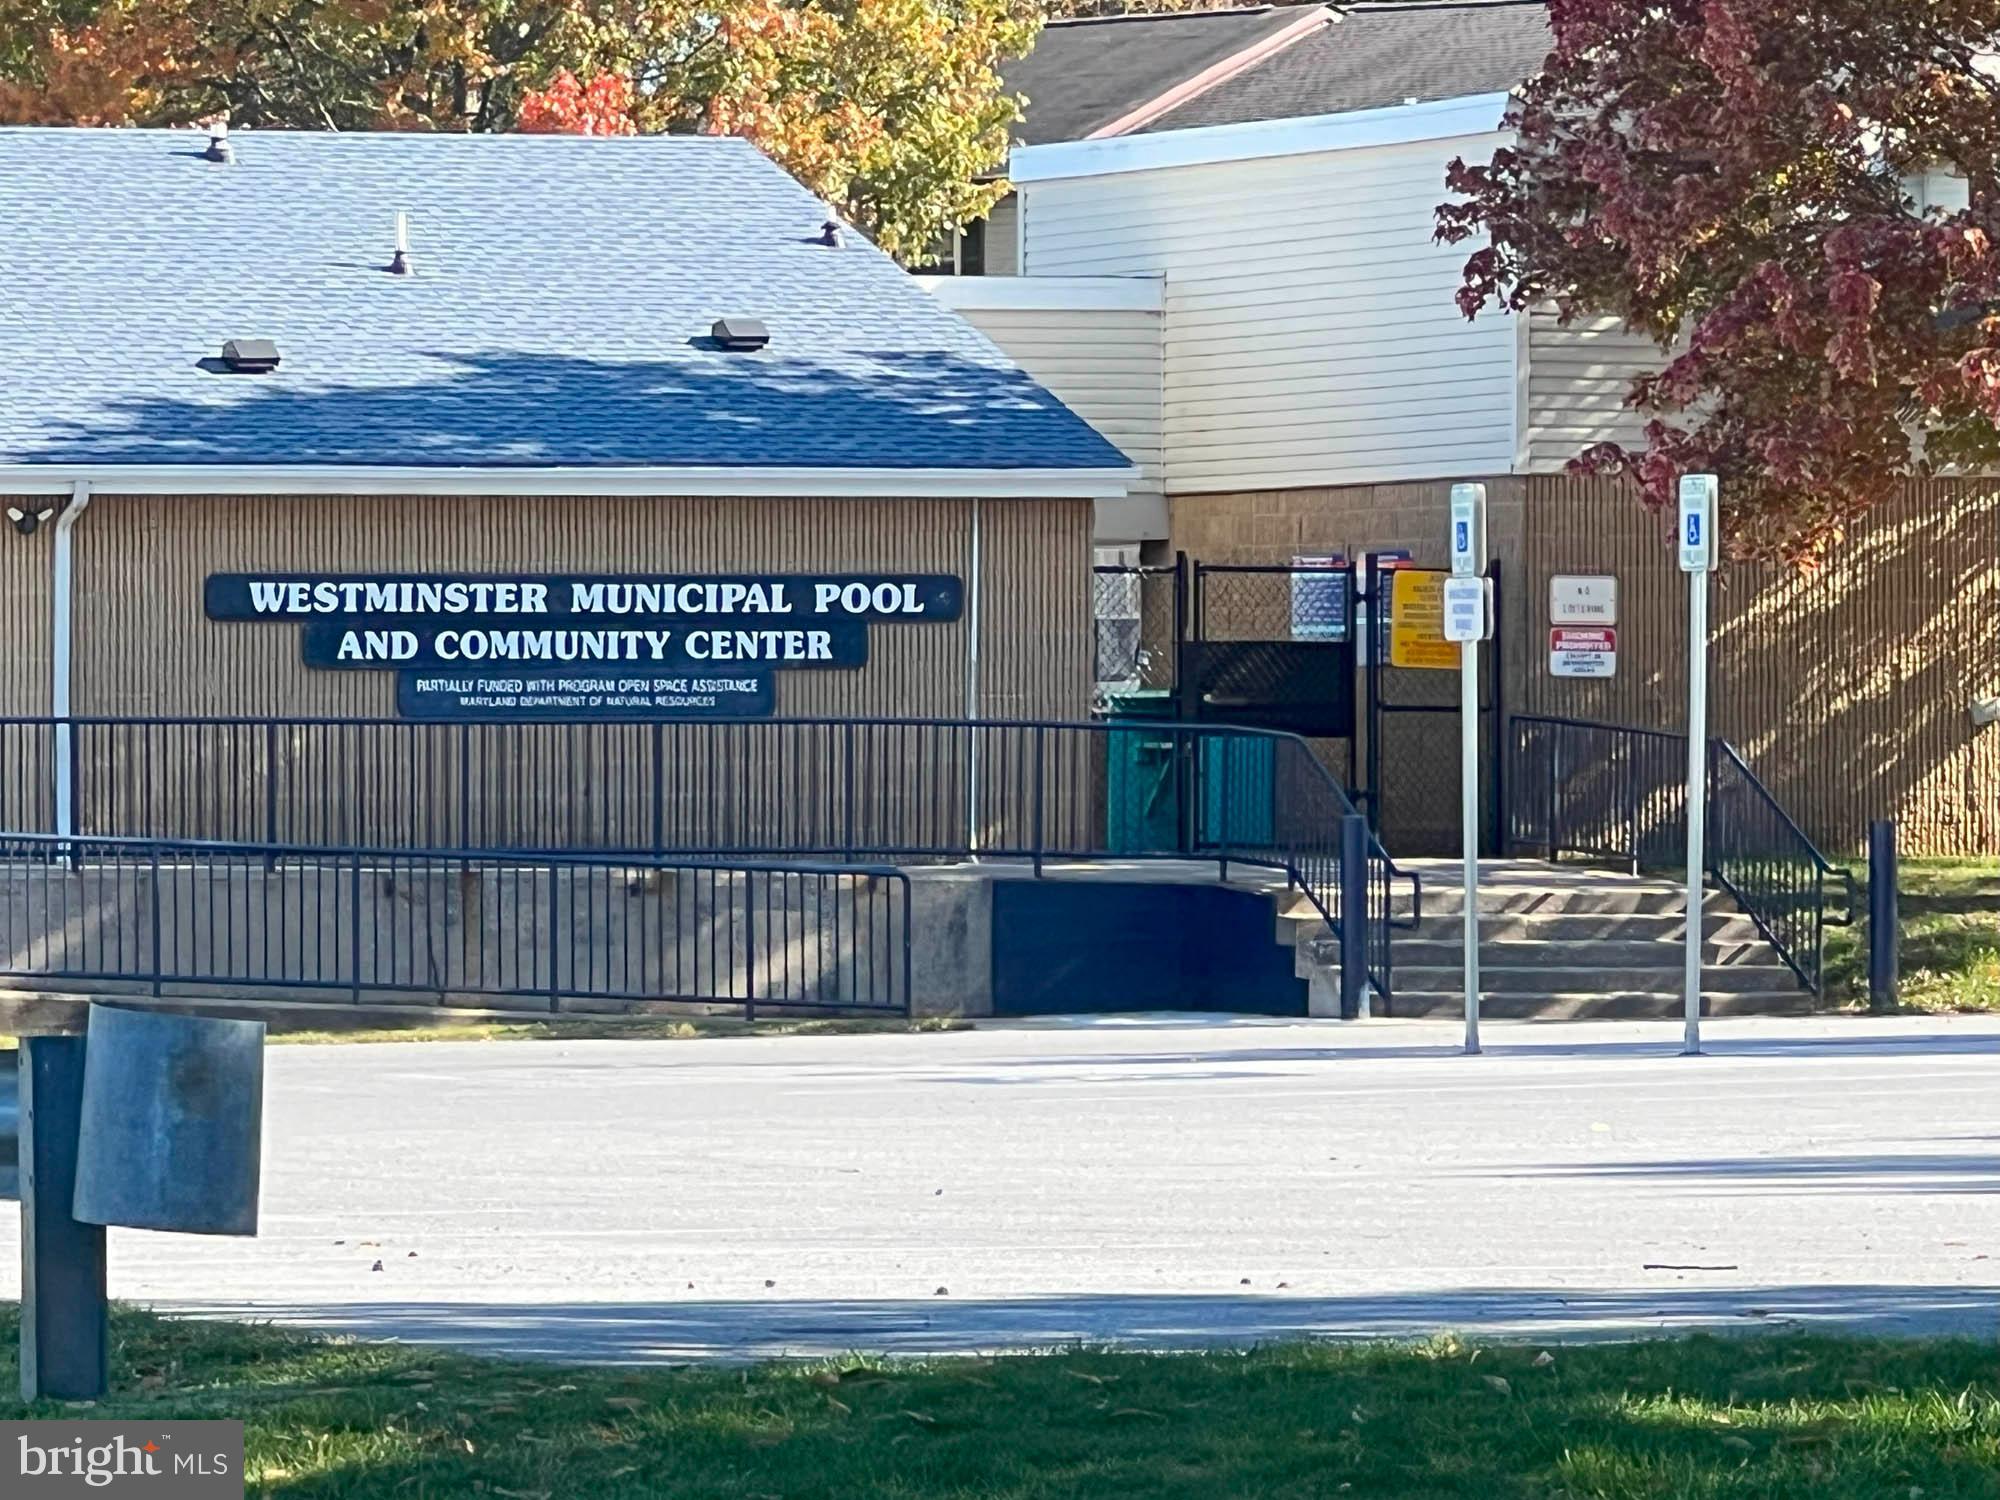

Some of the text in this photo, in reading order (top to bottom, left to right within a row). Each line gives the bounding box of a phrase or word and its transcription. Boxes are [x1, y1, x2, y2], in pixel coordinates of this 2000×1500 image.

[249, 582, 925, 613] WESTMINSTER MUNICIPAL POOL
[337, 630, 833, 660] AND COMMUNITY CENTER
[416, 679, 758, 693] PARTIALLY FUNDED WITH PROGRAM OPEN SPACE ASSISTANCE
[589, 695, 603, 707] OF
